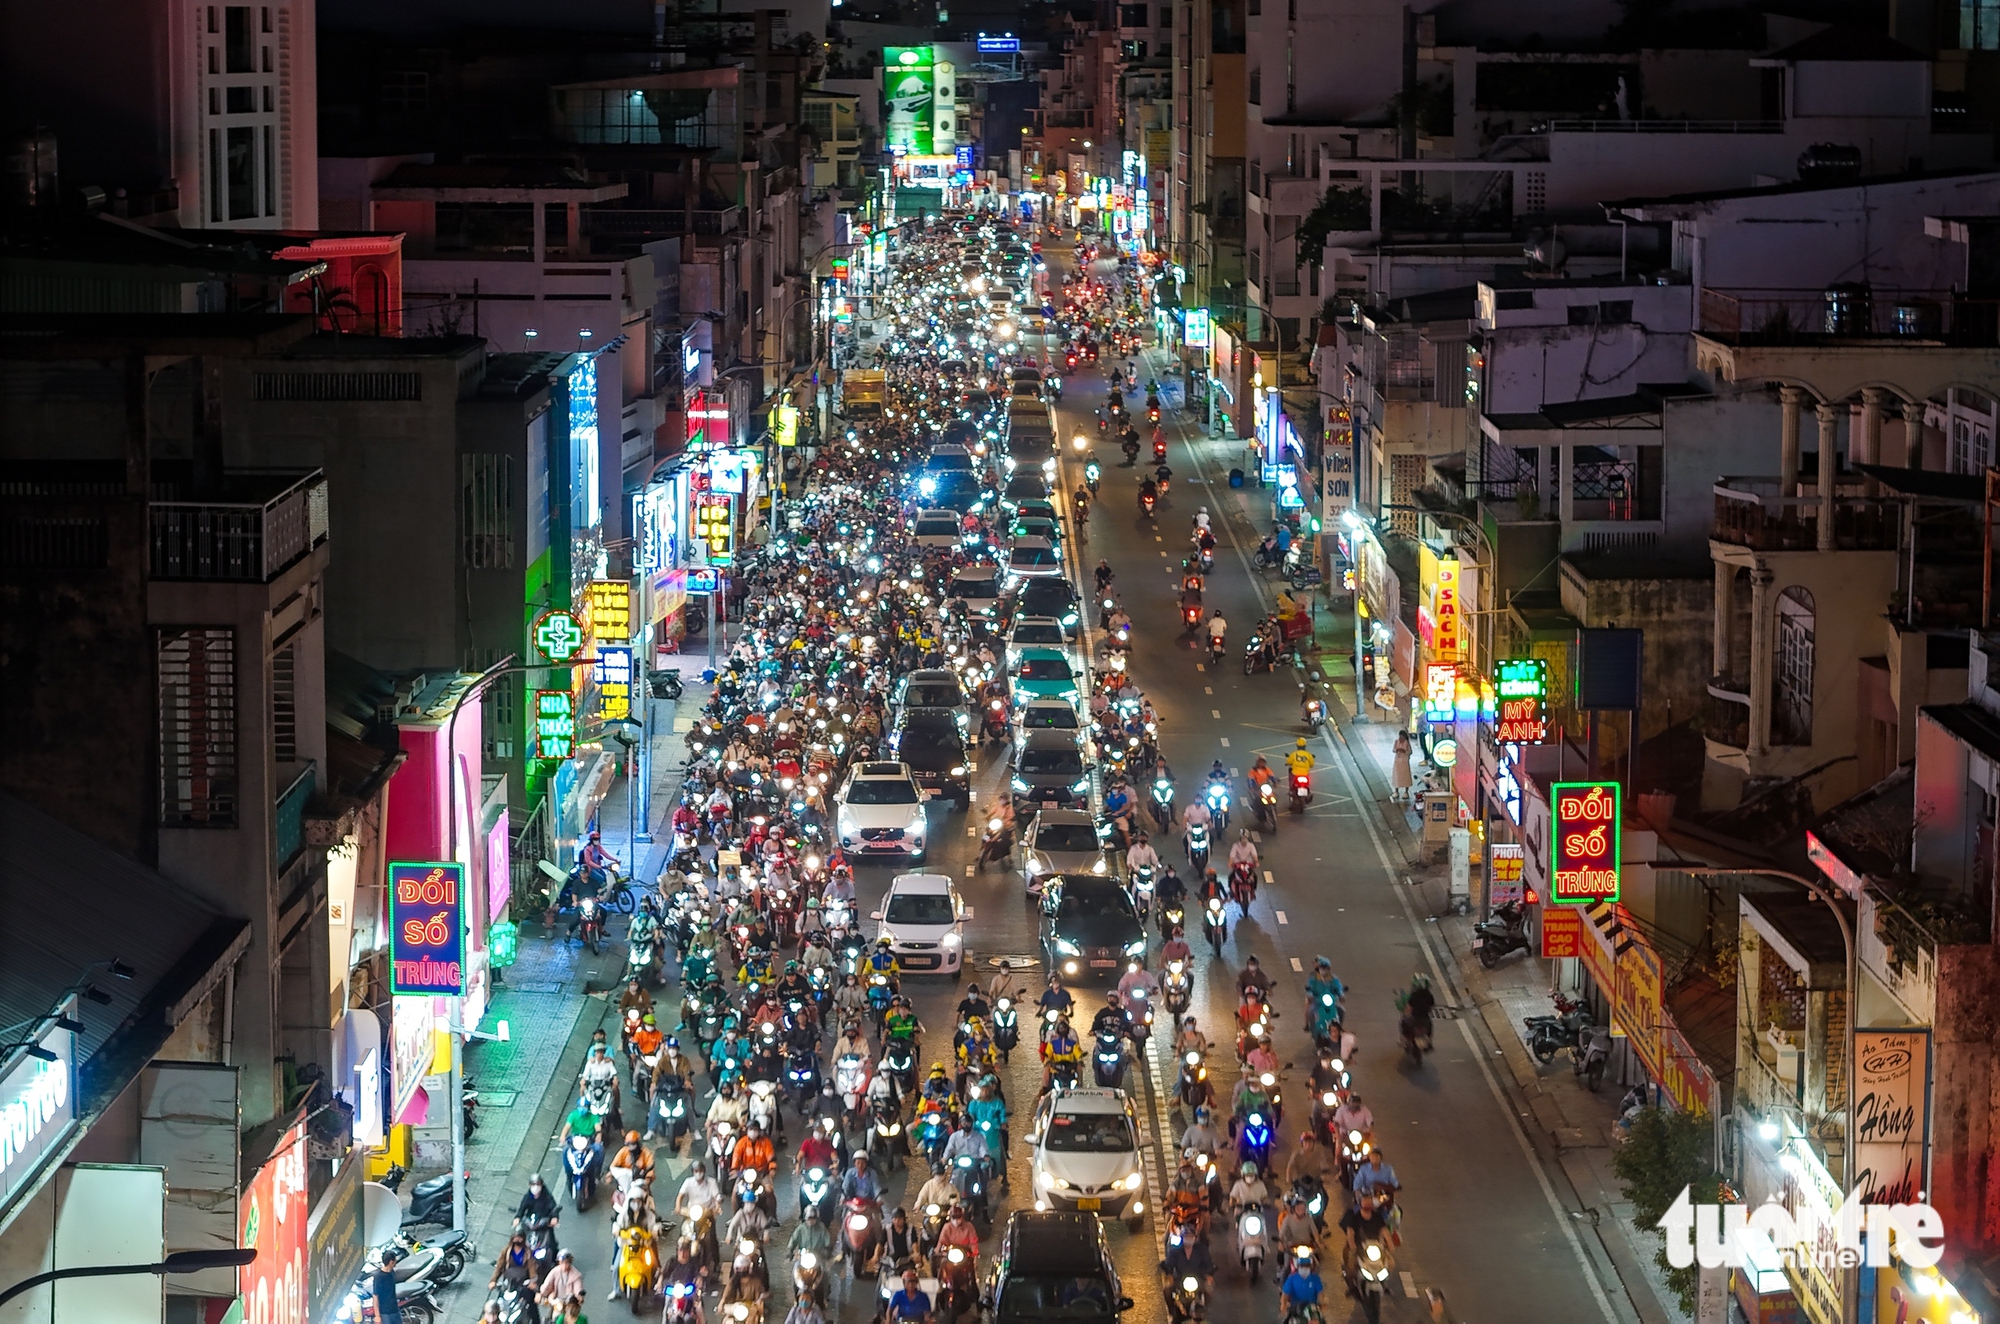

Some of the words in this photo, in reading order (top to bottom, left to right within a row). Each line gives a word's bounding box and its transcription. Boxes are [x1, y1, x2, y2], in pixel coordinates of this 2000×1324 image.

[1500, 680, 1540, 696] KÍNH
[540, 693, 571, 713] NHÀ
[1504, 697, 1536, 720] MỸ
[538, 713, 574, 736] THUỐC
[1498, 721, 1543, 740] ANH
[541, 736, 570, 757] TÂY
[1560, 787, 1613, 820] ĐỔI
[1566, 825, 1606, 857] SỐ
[398, 868, 455, 905] ĐỔI
[1555, 865, 1617, 893] TRÚNG
[404, 912, 449, 945] SỐ
[1544, 922, 1578, 932] TRANH
[1548, 934, 1574, 943] CAO
[394, 955, 461, 986] TRÚNG
[1857, 1092, 1915, 1151] Hồng
